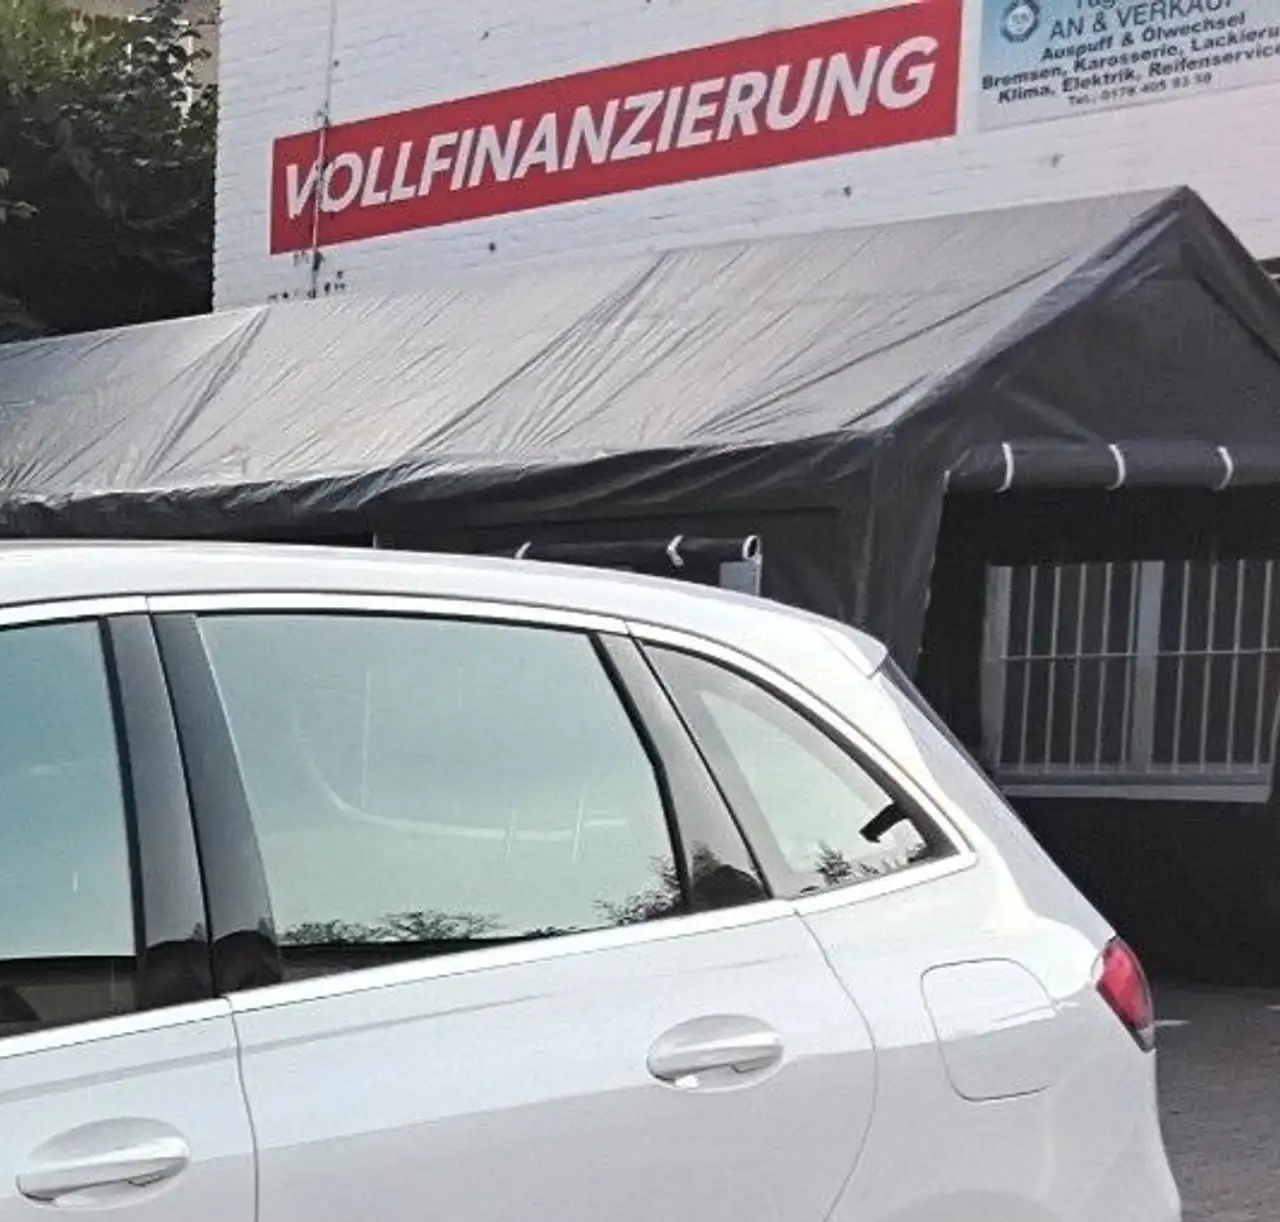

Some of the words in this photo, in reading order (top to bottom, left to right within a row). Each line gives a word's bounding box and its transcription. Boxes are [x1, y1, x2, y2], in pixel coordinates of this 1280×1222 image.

[1049, 15, 1085, 41] AN
[1092, 10, 1107, 32] &
[1040, 35, 1113, 61] Auspuff
[1122, 30, 1135, 47] &
[982, 66, 1067, 90] Bremsen,
[1073, 44, 1184, 73] Karosserie,
[998, 85, 1055, 104] Klima,
[1061, 67, 1140, 93] Elektrik,
[284, 35, 938, 220] VOLLFINANZIERUNG
